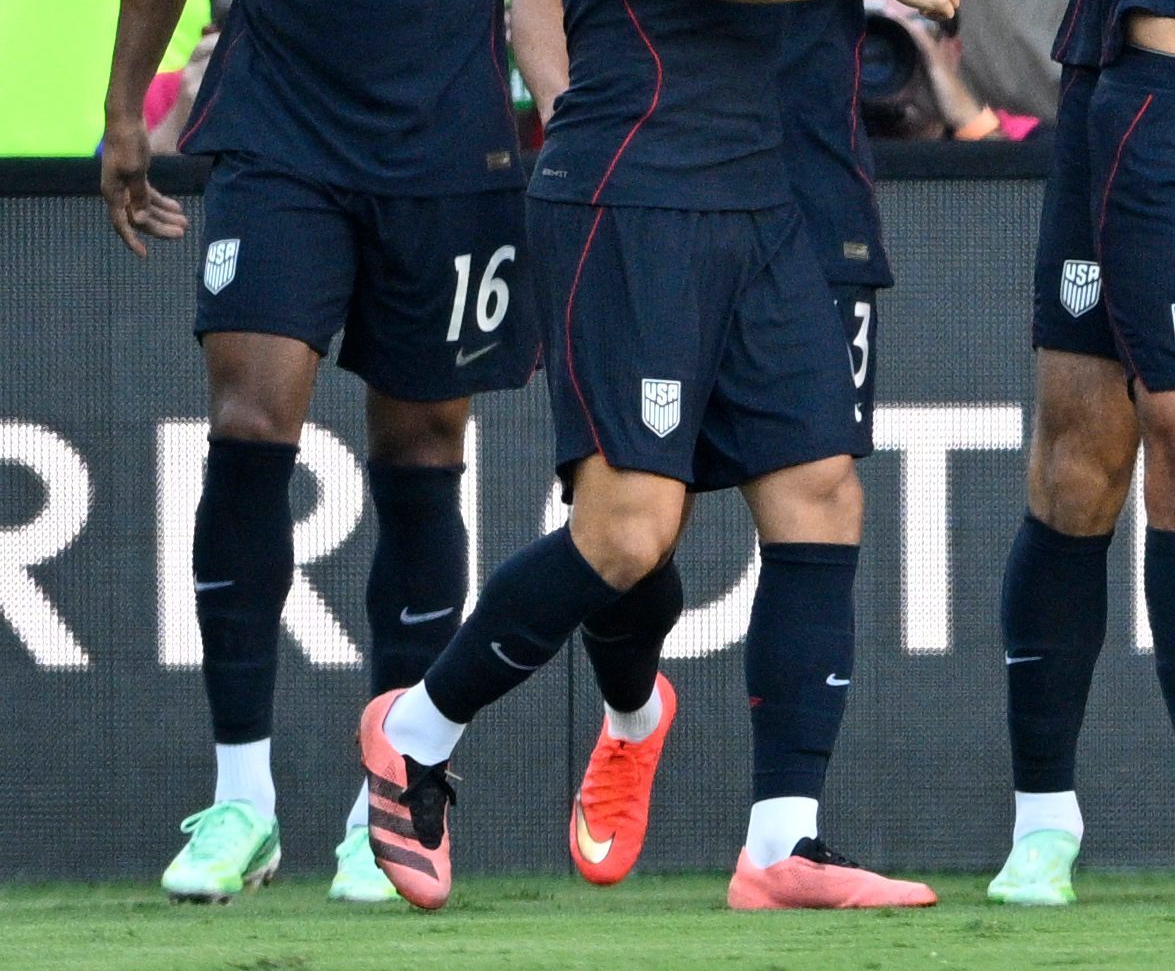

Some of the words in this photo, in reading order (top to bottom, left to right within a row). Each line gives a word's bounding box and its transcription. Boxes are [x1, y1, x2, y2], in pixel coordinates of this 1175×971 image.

[209, 241, 237, 265] USA
[1065, 263, 1100, 286] USA
[446, 245, 516, 342] 16
[645, 382, 678, 406] USA
